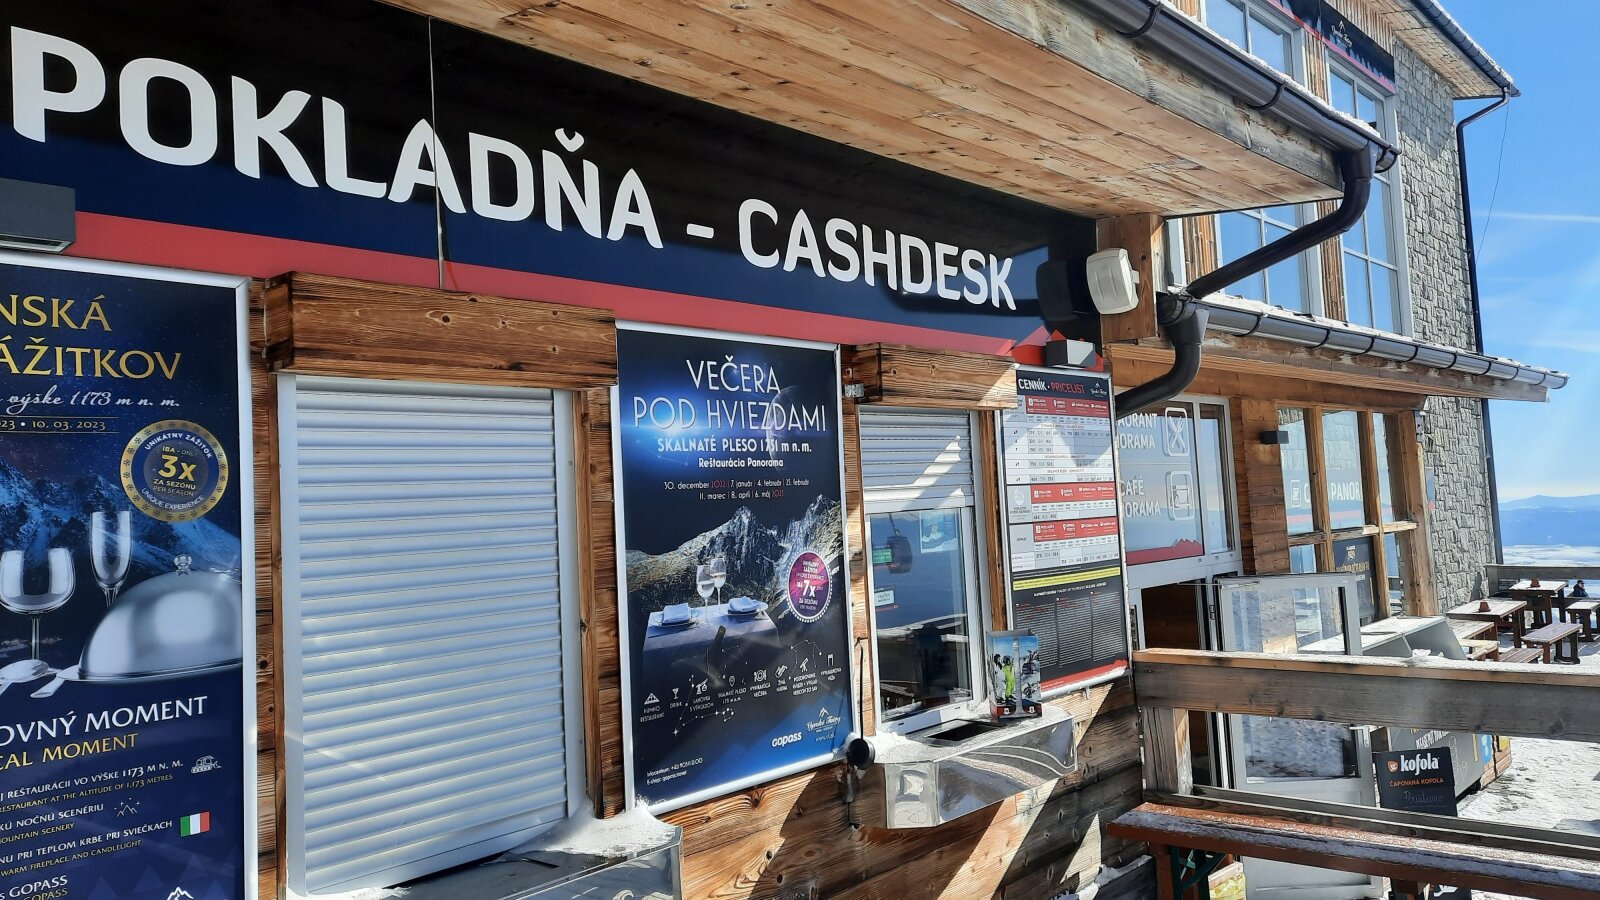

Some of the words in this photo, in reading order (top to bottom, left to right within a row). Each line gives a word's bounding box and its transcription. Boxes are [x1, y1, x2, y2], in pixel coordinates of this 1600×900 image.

[11, 26, 663, 249] POKLADŇA
[687, 224, 714, 240] -
[738, 199, 1017, 311] CASHDESK
[686, 354, 781, 394] VEČERA
[1018, 378, 1047, 391] CENNÍK
[1050, 382, 1085, 394] PRICELIST
[6, 385, 64, 415] výške
[70, 391, 112, 406] 1173
[115, 398, 134, 406] m
[633, 396, 696, 430] POD
[707, 399, 826, 432] HVIEZDAMI
[32, 421, 49, 429] 10.
[53, 421, 73, 431] 03.
[76, 421, 106, 431] 2023
[144, 432, 184, 451] UNIKÁTNY
[185, 433, 213, 459] ZÁŽITOK
[657, 435, 717, 452] SKALNATÉ
[722, 438, 757, 452] PLESO
[698, 457, 745, 468] Reštaurácia
[747, 457, 784, 467] Panorama
[166, 480, 196, 490] SEZÓNU
[167, 488, 194, 497] SEASON
[677, 480, 710, 490] december
[1120, 475, 1144, 496] CAFÉ
[141, 487, 164, 508] UNIQUE
[164, 495, 205, 510] EXPERIENCE
[1121, 501, 1161, 517] ORAMA
[84, 696, 208, 733] MOMENT
[42, 733, 138, 763] MOMENT
[1401, 753, 1438, 775] kofola
[7, 780, 71, 799] REŠTAURÁCII
[74, 777, 88, 786] VO
[91, 771, 119, 783] VÝŠKE
[122, 766, 144, 778] 1173
[147, 764, 156, 772] M
[158, 762, 169, 770] N.
[171, 760, 184, 768] M.
[50, 795, 60, 803] AT
[79, 786, 112, 797] ALTITUDE
[147, 773, 173, 784] METRES
[1390, 777, 1419, 787] ČAPOVANÁ
[1421, 777, 1444, 785] KOFOLA
[16, 811, 55, 828] NOČNÚ
[58, 803, 104, 819] SCENÉRIU
[0, 830, 39, 844] OUNTAIN
[41, 822, 75, 834] SCENERY
[17, 850, 33, 860] PRI
[36, 841, 76, 856] TEPLOM
[80, 834, 103, 847] KRBE
[106, 831, 120, 841] PRI
[123, 820, 173, 837] SVIEČKACH
[0, 866, 27, 877] WARM
[30, 855, 70, 870] FIREPLACE
[71, 851, 89, 861] AND
[91, 840, 142, 856] CANDLELIGHT
[9, 875, 68, 898] GOPASS
